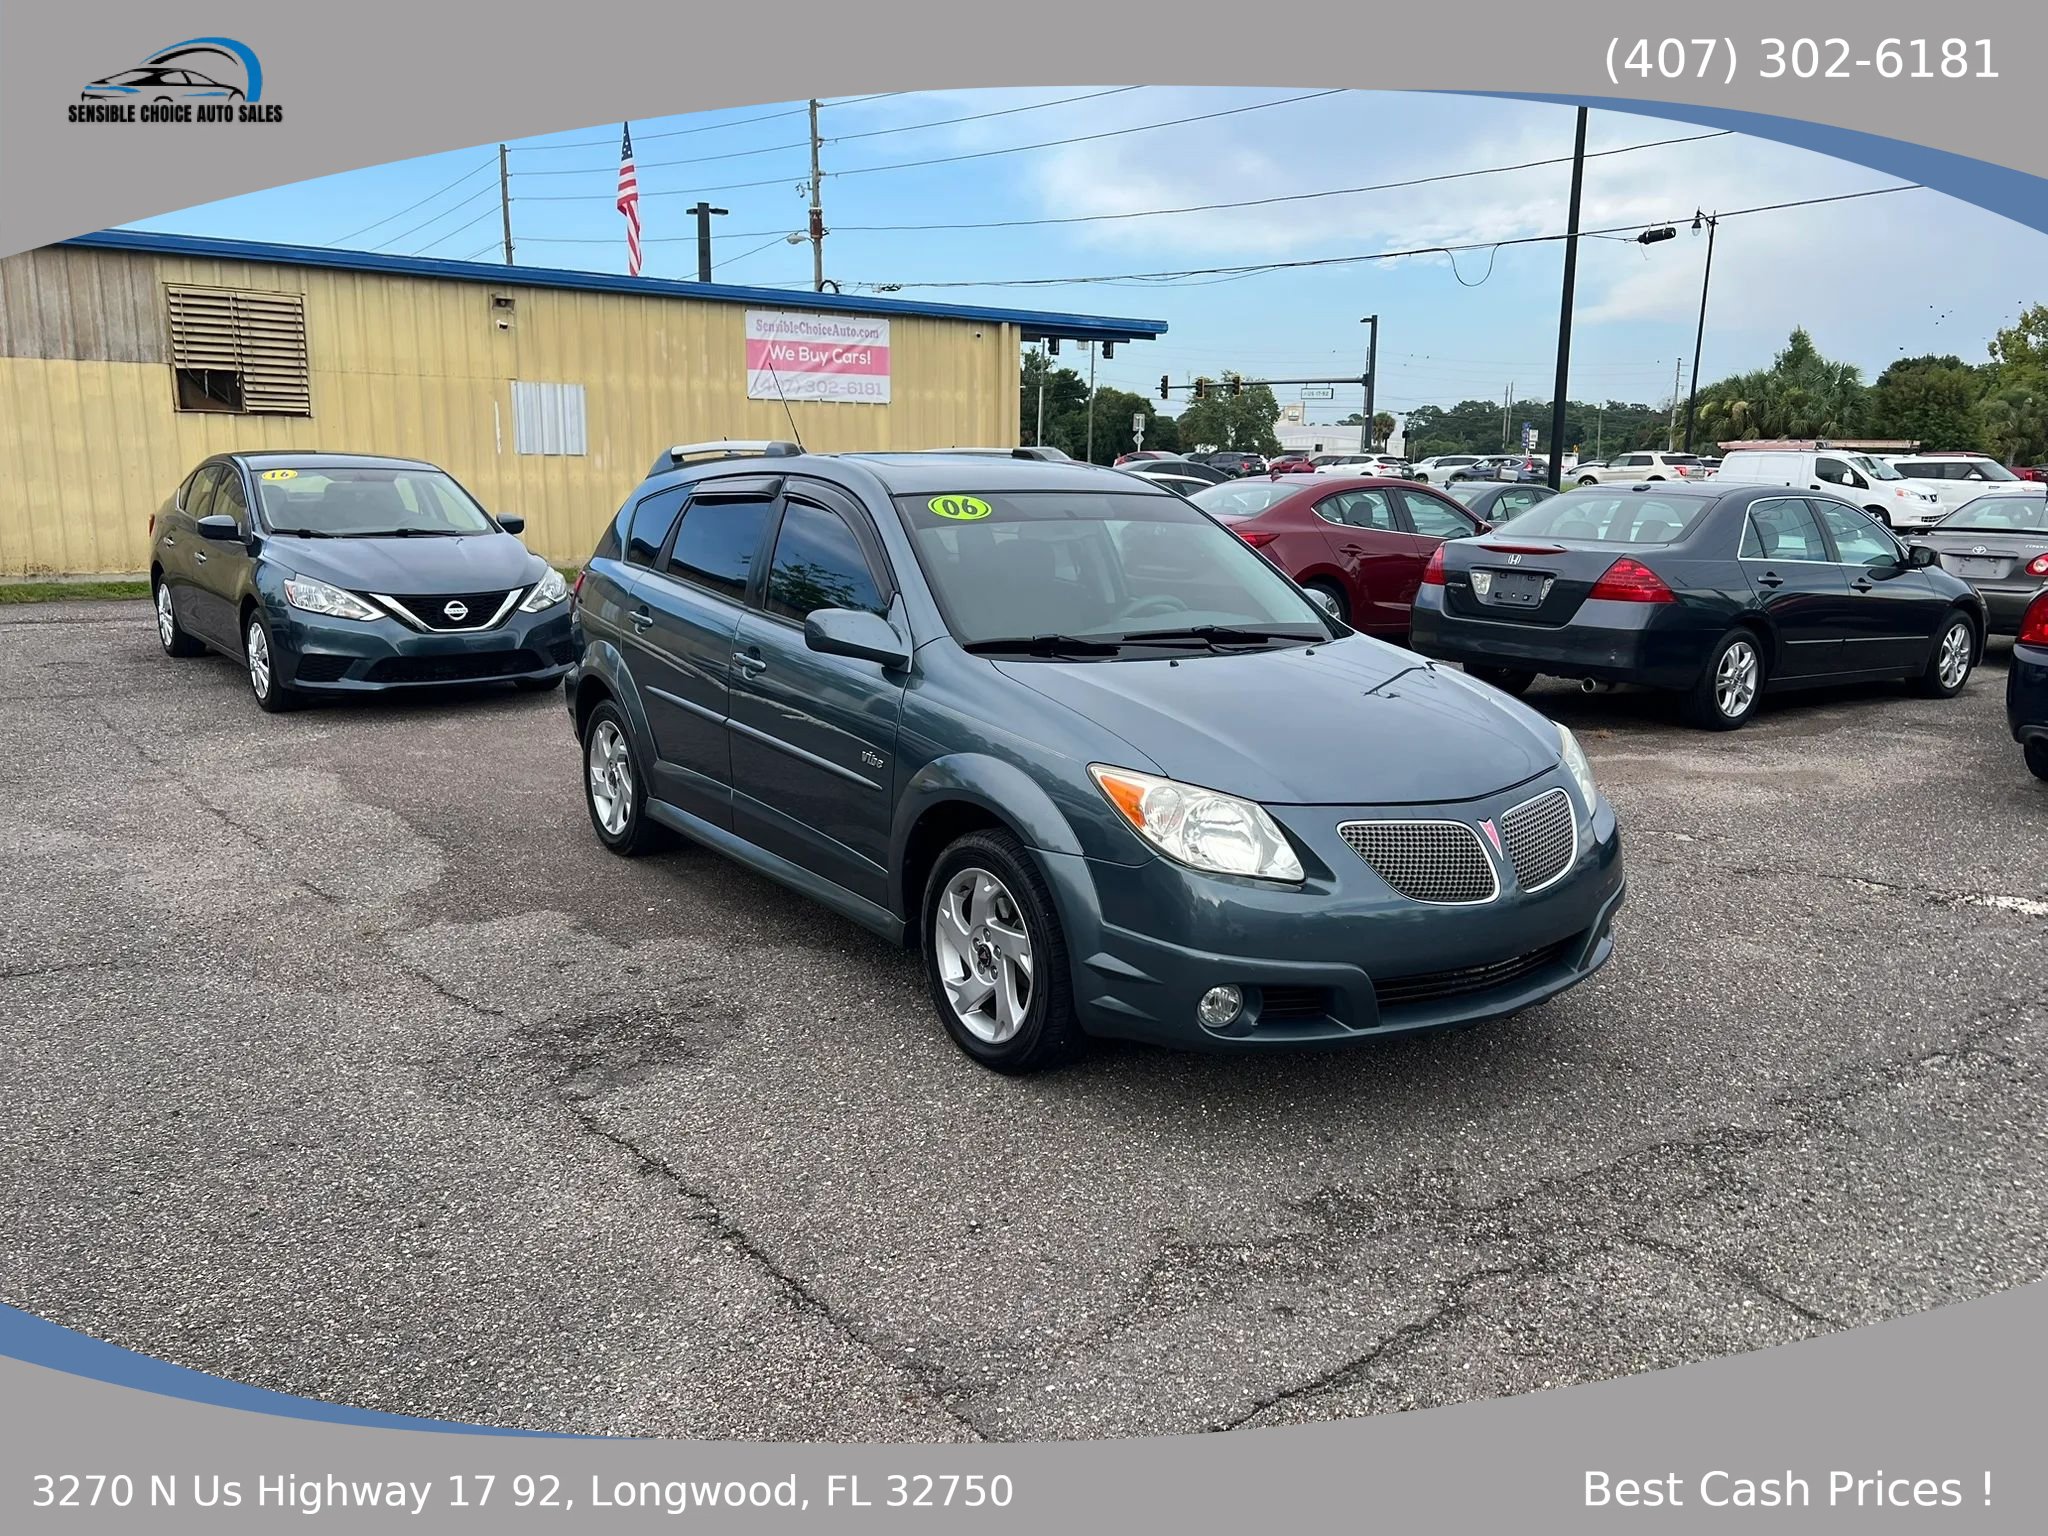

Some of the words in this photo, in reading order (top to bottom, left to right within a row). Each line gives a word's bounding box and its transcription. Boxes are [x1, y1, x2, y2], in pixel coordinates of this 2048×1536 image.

[756, 319, 880, 339] SensibleChoiceAuto.com
[768, 345, 795, 361] We
[799, 347, 829, 366] Buy
[832, 349, 871, 365] Cars!
[805, 380, 883, 396] 302-6181
[271, 471, 289, 479] 16
[942, 499, 978, 516] 06
